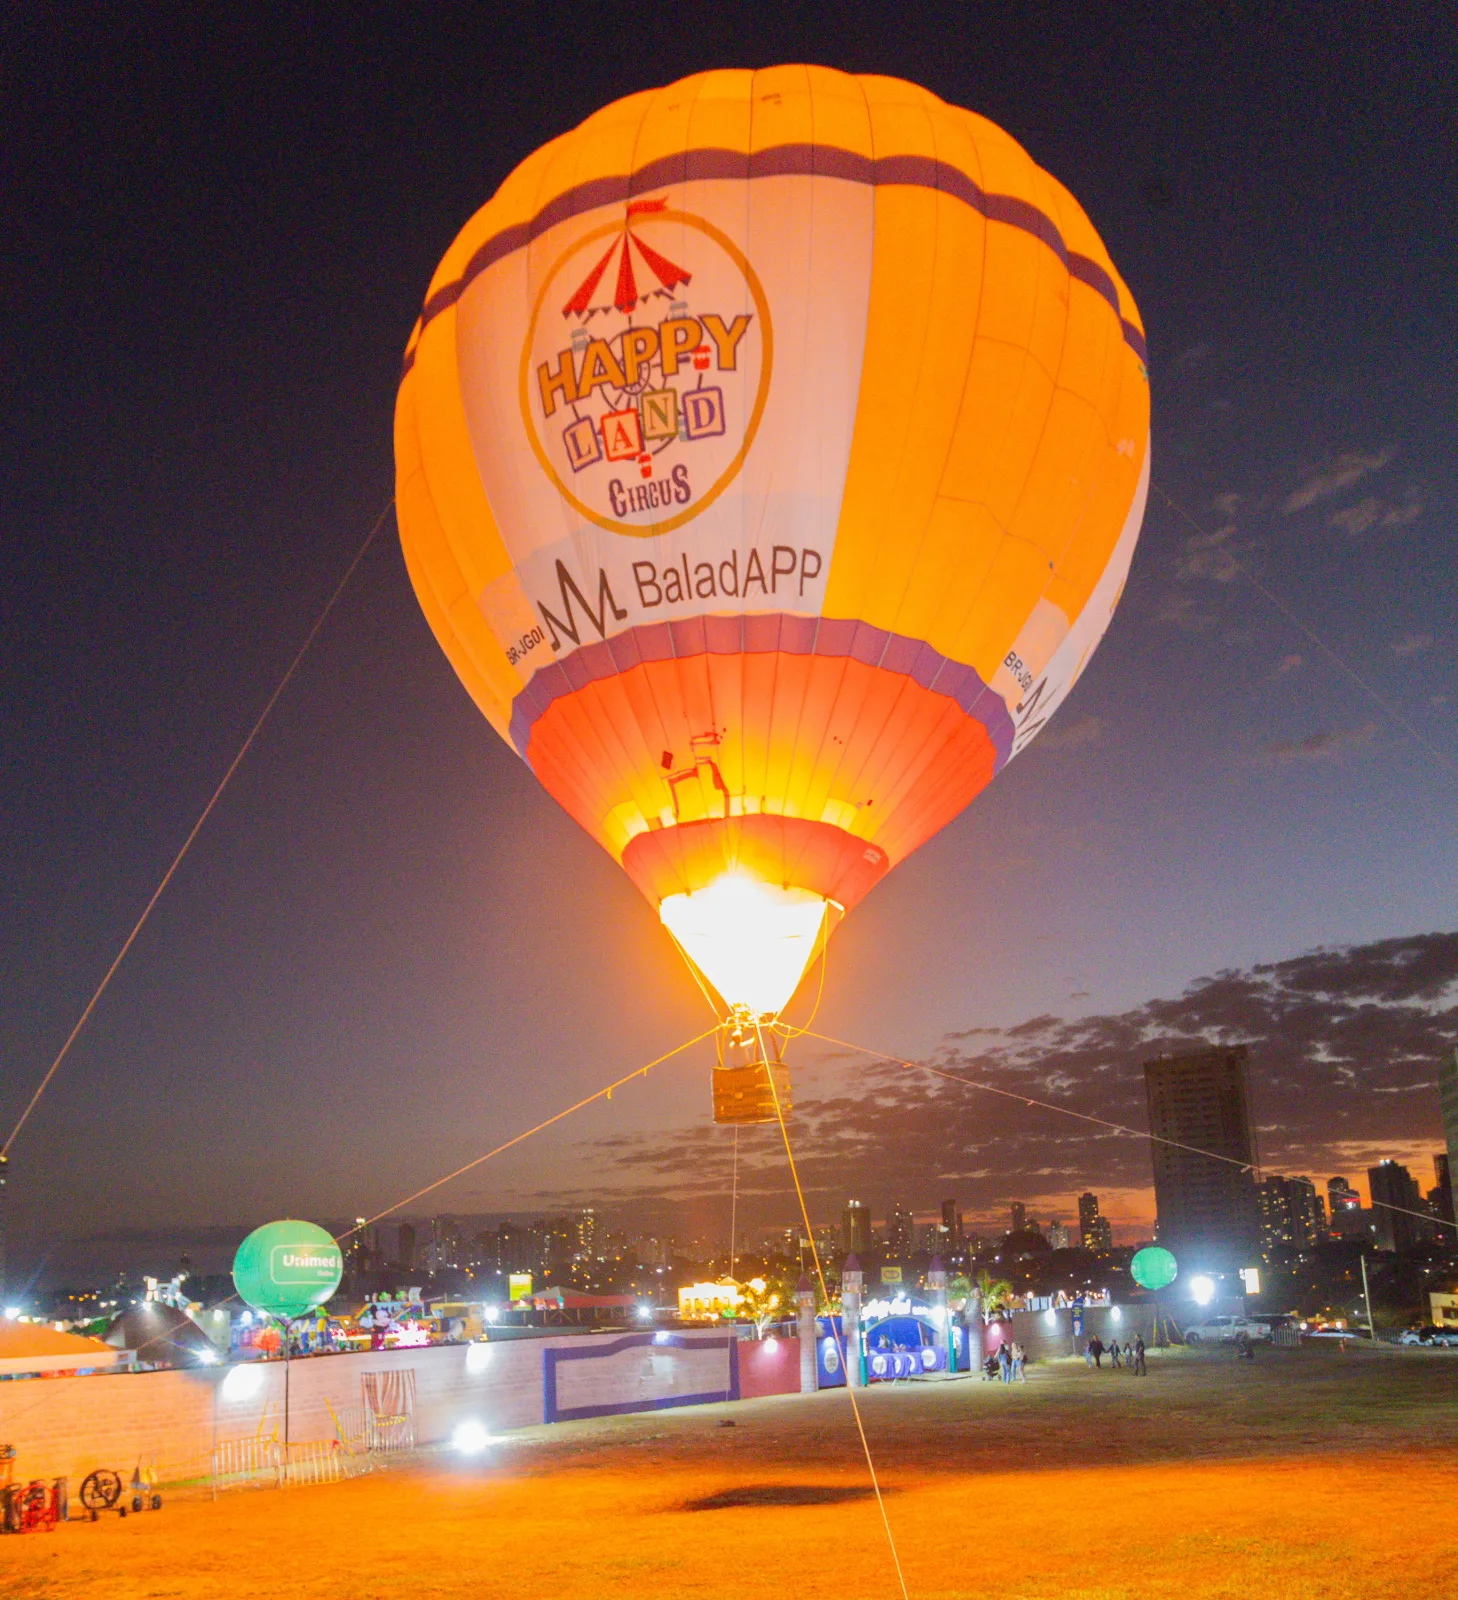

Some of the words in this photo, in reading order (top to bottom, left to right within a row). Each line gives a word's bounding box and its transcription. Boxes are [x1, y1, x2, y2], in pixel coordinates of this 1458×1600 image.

[537, 313, 753, 419] HAPPY
[565, 391, 720, 464] LAND
[608, 463, 692, 518] CIRCUS
[631, 545, 823, 609] BaladAPP
[283, 1253, 336, 1268] Unimed
